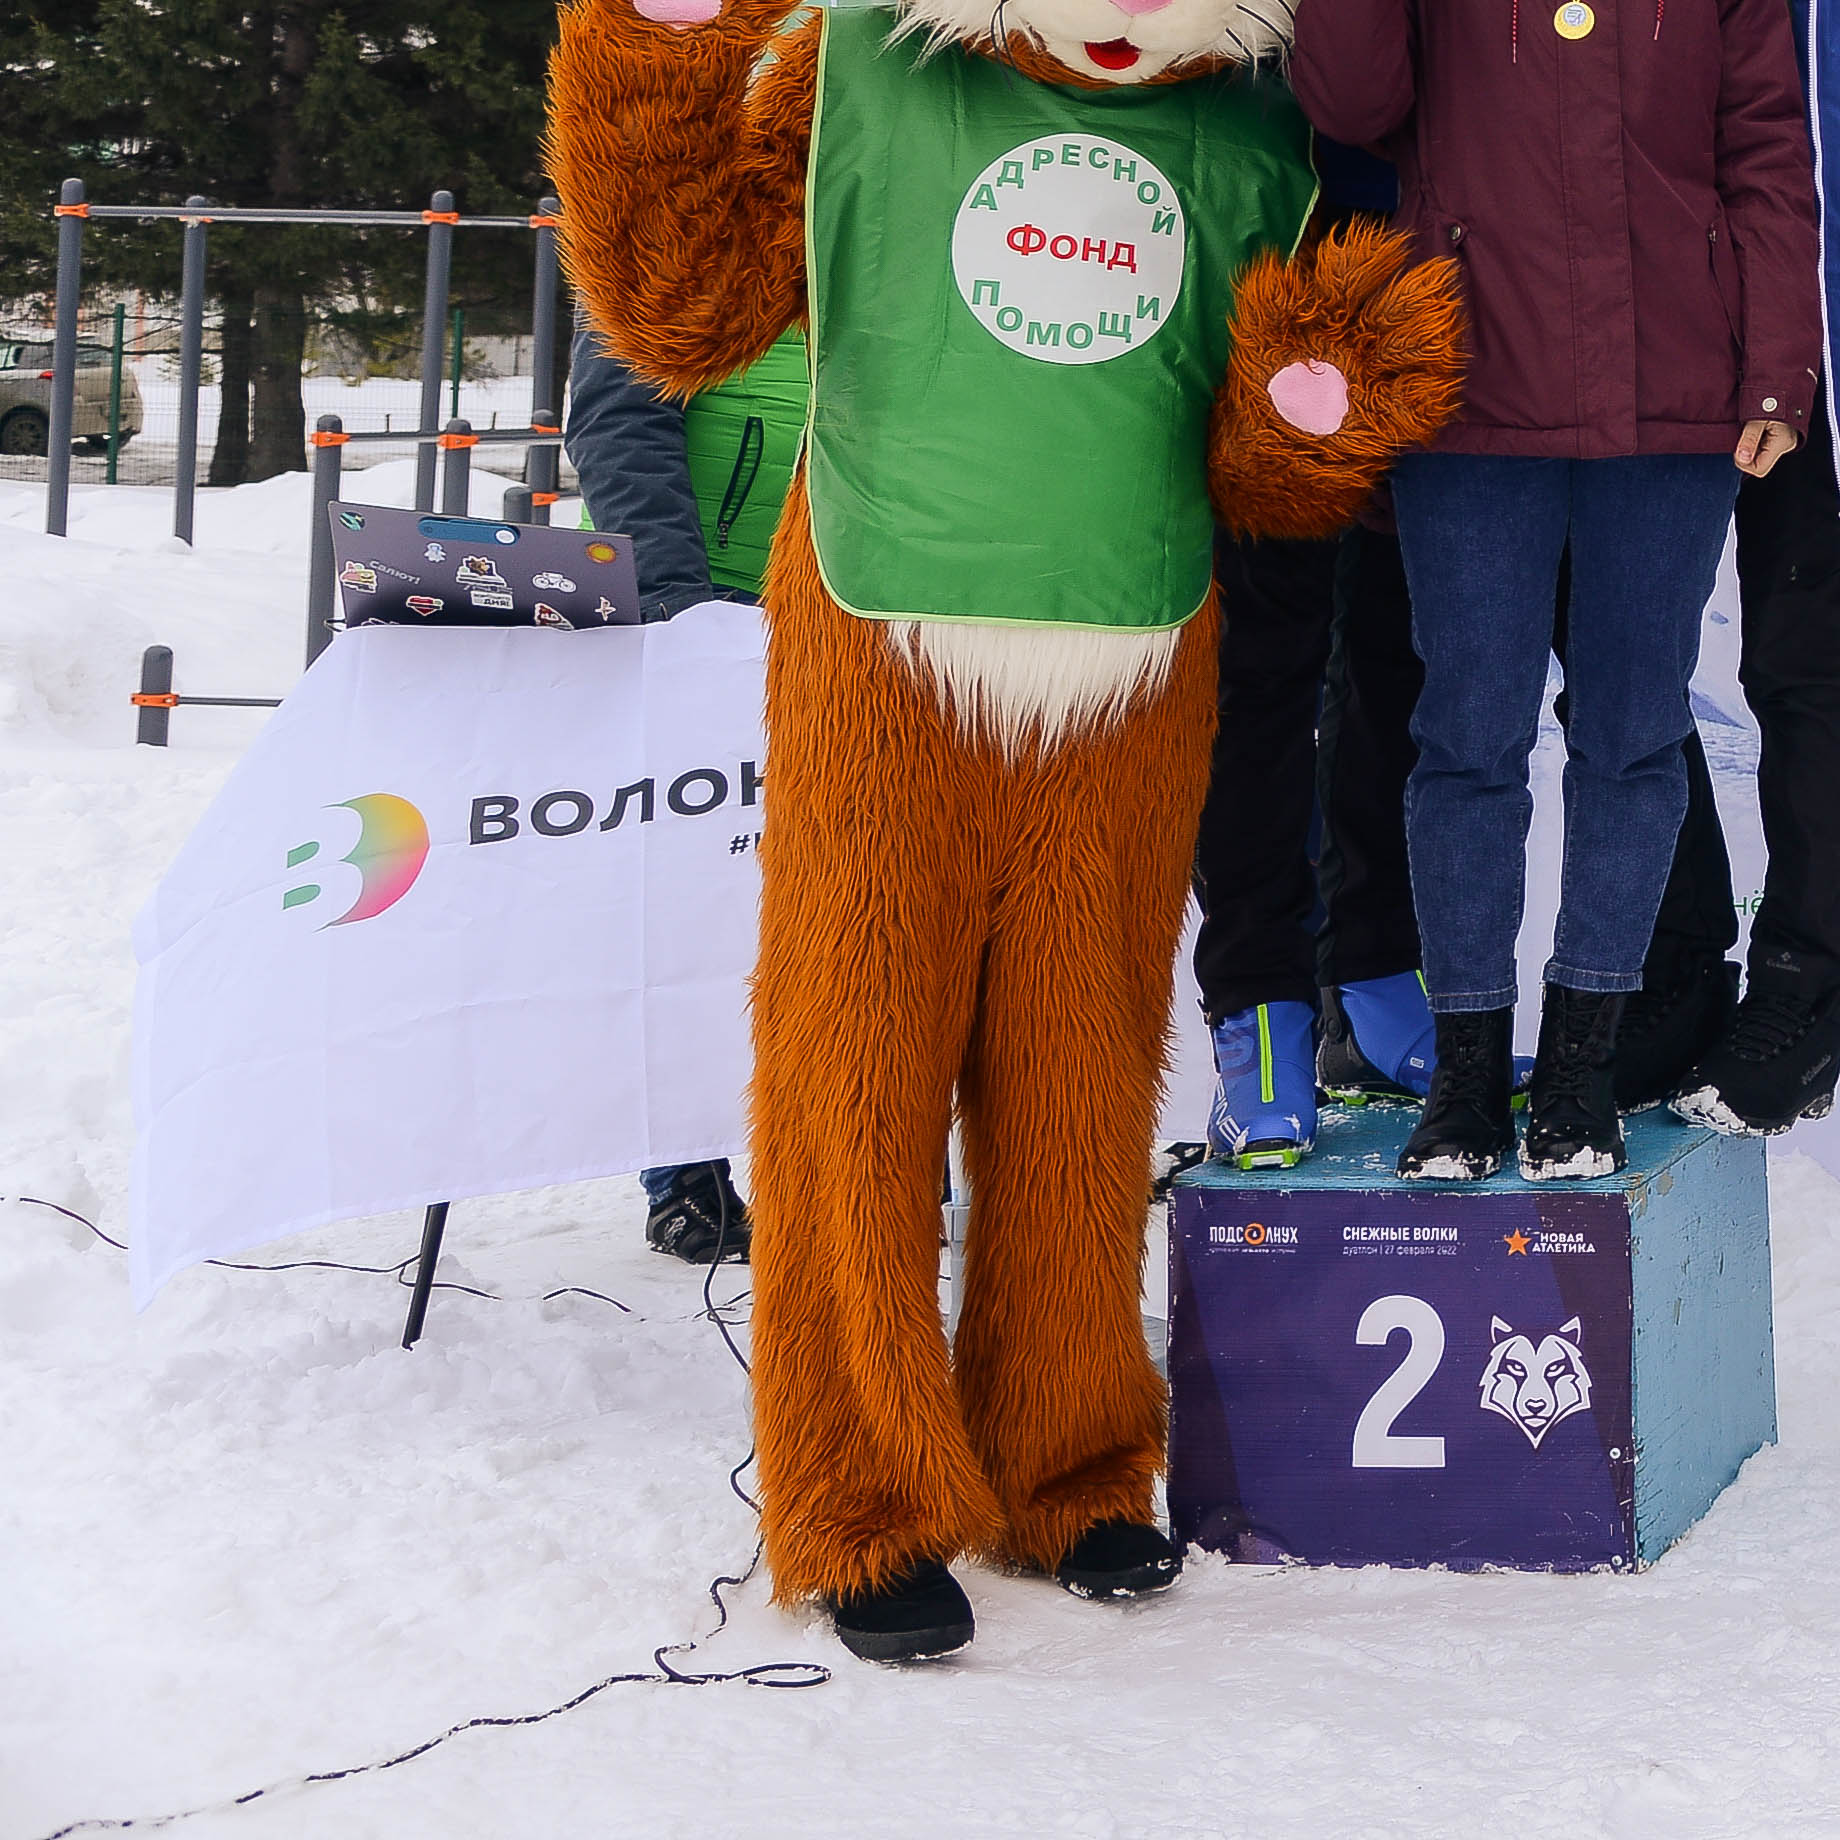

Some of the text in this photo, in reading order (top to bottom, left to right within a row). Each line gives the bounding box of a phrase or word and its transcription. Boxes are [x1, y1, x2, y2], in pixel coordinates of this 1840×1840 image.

[970, 143, 1177, 237] АДРЕСНОЙ
[972, 279, 1160, 350] ПОМОЩИ
[1343, 1226, 1458, 1241] СНЕЖНЫЕ ВОЛКИ
[1531, 1242, 1596, 1253] АТЛЕТИКА
[1540, 1232, 1584, 1243] НОВАЯ
[1352, 1294, 1446, 1469] 2
